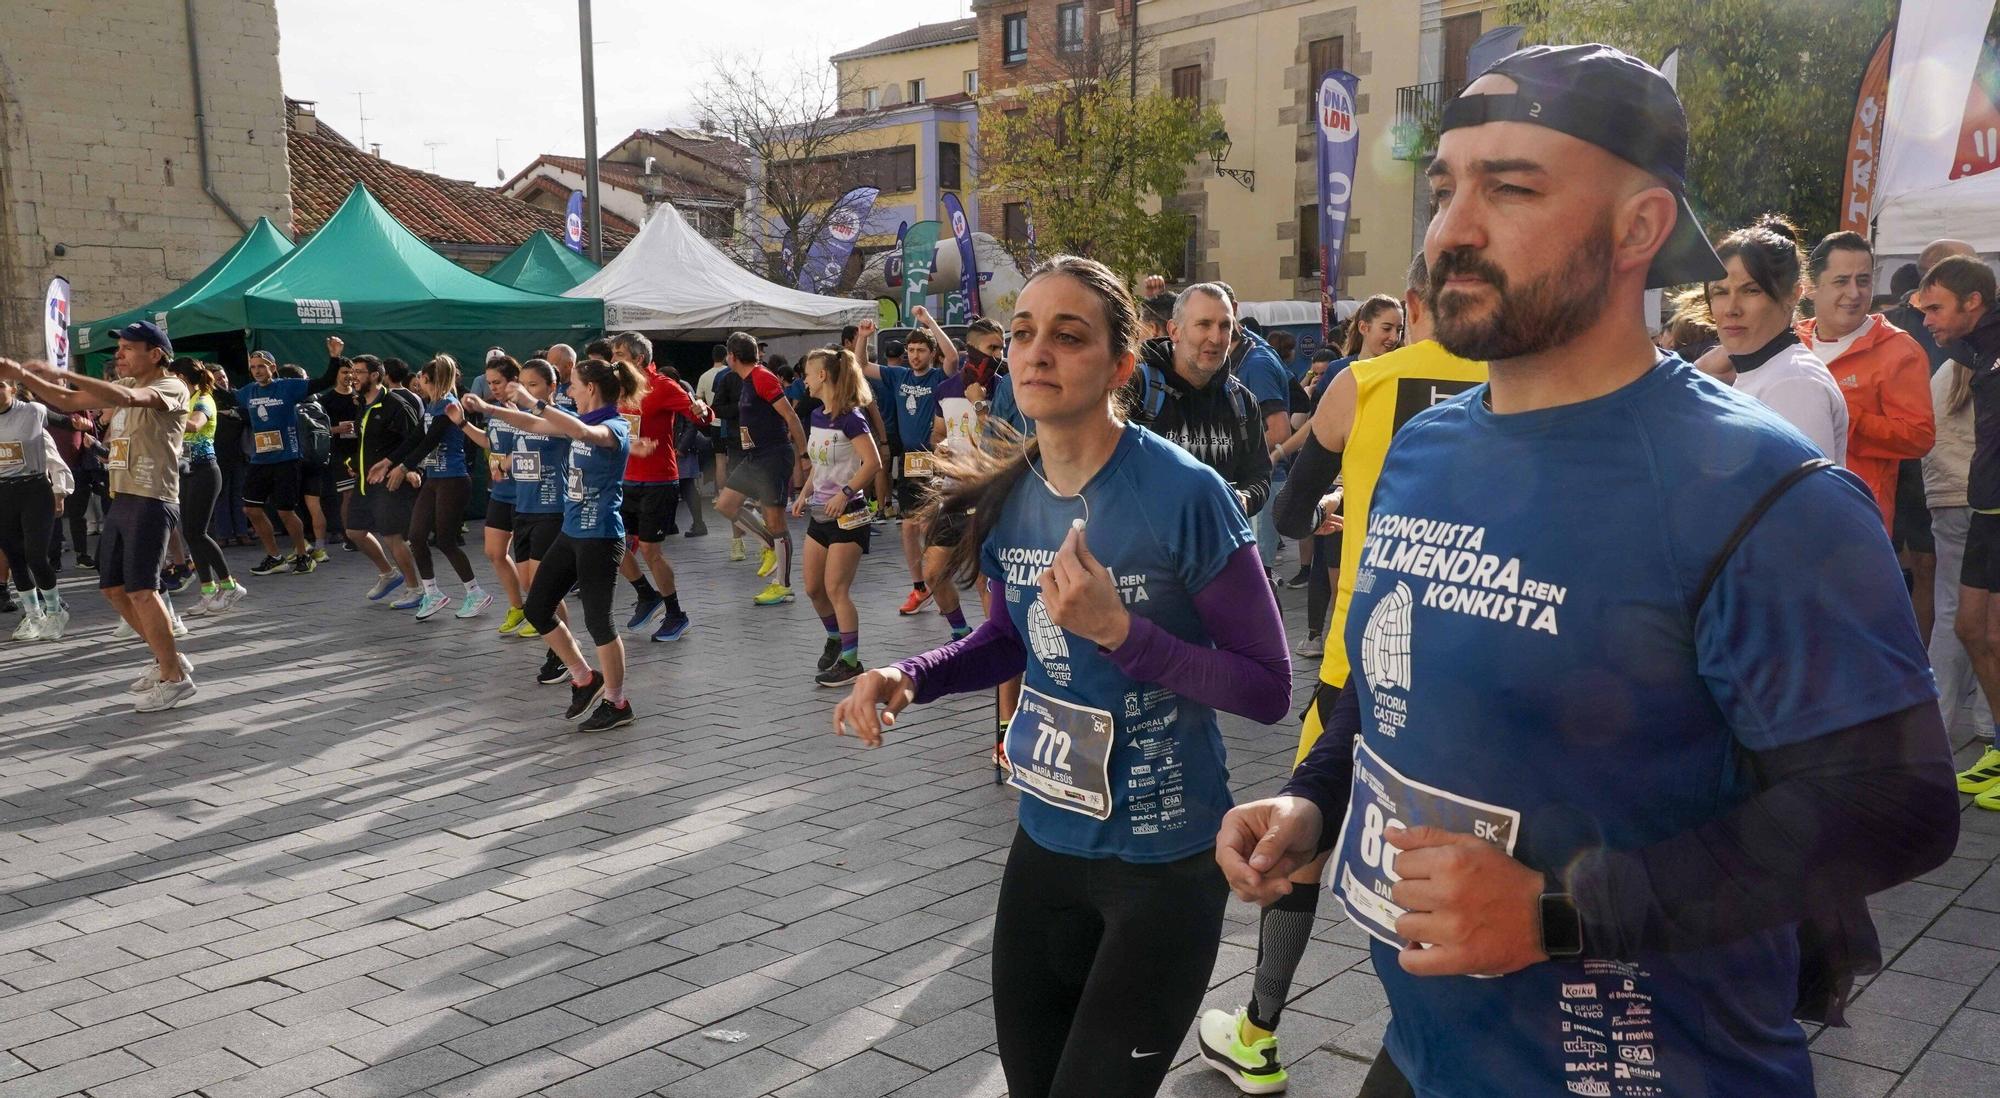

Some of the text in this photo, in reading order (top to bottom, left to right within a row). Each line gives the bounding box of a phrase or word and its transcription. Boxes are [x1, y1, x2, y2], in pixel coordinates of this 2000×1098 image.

[295, 298, 332, 307] VITORIA
[297, 307, 334, 317] GASTEIZ
[516, 459, 534, 471] 1033
[1376, 515, 1486, 552] CONQUISTA
[1120, 574, 1147, 586] REN
[1365, 540, 1521, 594] ALMENDRA
[1521, 578, 1568, 606] REN
[1421, 581, 1559, 636] KONKISTA
[1044, 662, 1071, 672] VITORIA
[1047, 671, 1072, 680] GASTEIZ
[1374, 690, 1408, 714] VITORIA
[1373, 705, 1407, 728] GASTEIZ
[1093, 721, 1106, 733] 5K
[1378, 721, 1396, 738] 2025
[1032, 722, 1072, 772] 772
[1032, 763, 1073, 785] MARÍA JESÚS
[1473, 820, 1500, 842] 5K
[1564, 986, 1594, 998] Kaiku
[1573, 1004, 1603, 1012] GRUPO
[1564, 1036, 1607, 1058] udapa
[1565, 1063, 1608, 1073] BAKH
[1567, 1080, 1610, 1096] FORONDA
